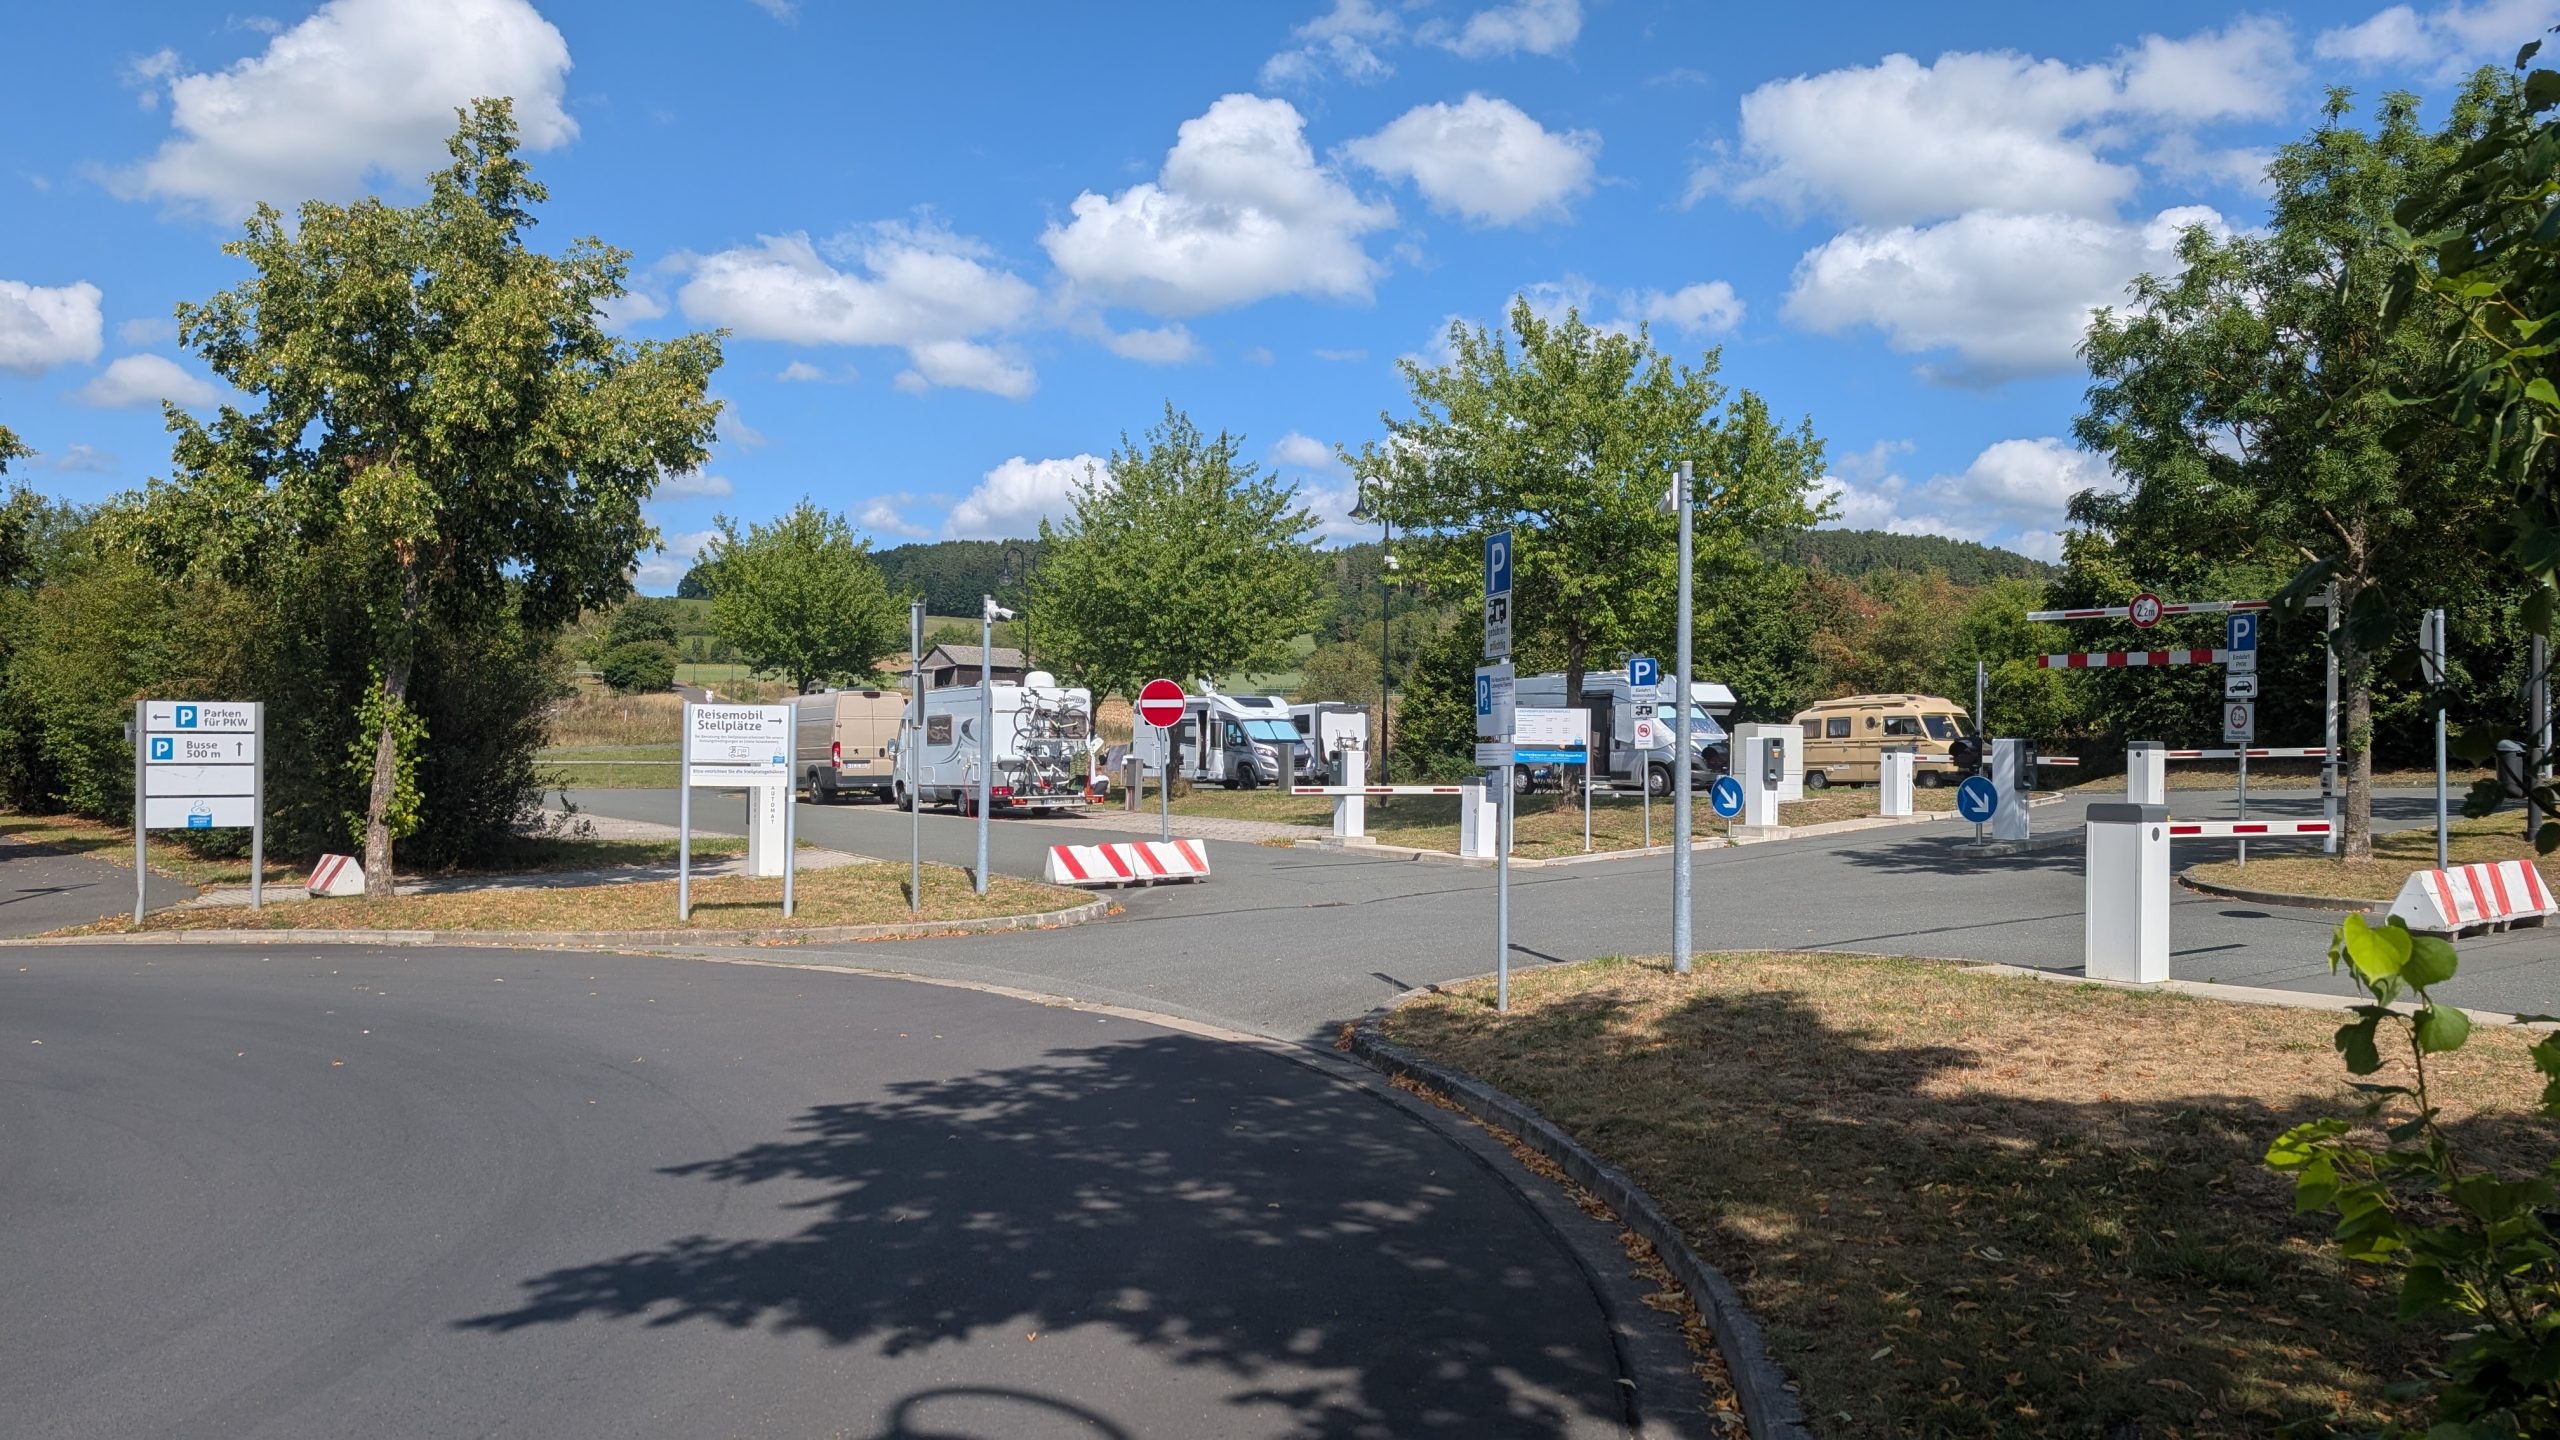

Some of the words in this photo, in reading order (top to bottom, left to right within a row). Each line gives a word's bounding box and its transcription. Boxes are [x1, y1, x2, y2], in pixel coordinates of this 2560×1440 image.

[1491, 542, 1506, 591] P
[2233, 618, 2250, 649] P
[1634, 661, 1651, 685] P
[180, 709, 193, 725] P
[204, 708, 242, 718] Parken
[697, 708, 763, 720] Reisemobil
[204, 717, 220, 727] für
[223, 718, 248, 727] PKW
[697, 720, 762, 733] Stellplätze
[156, 741, 169, 757] P
[186, 740, 218, 750] Busse
[186, 750, 208, 759] 500
[211, 751, 221, 759] m
